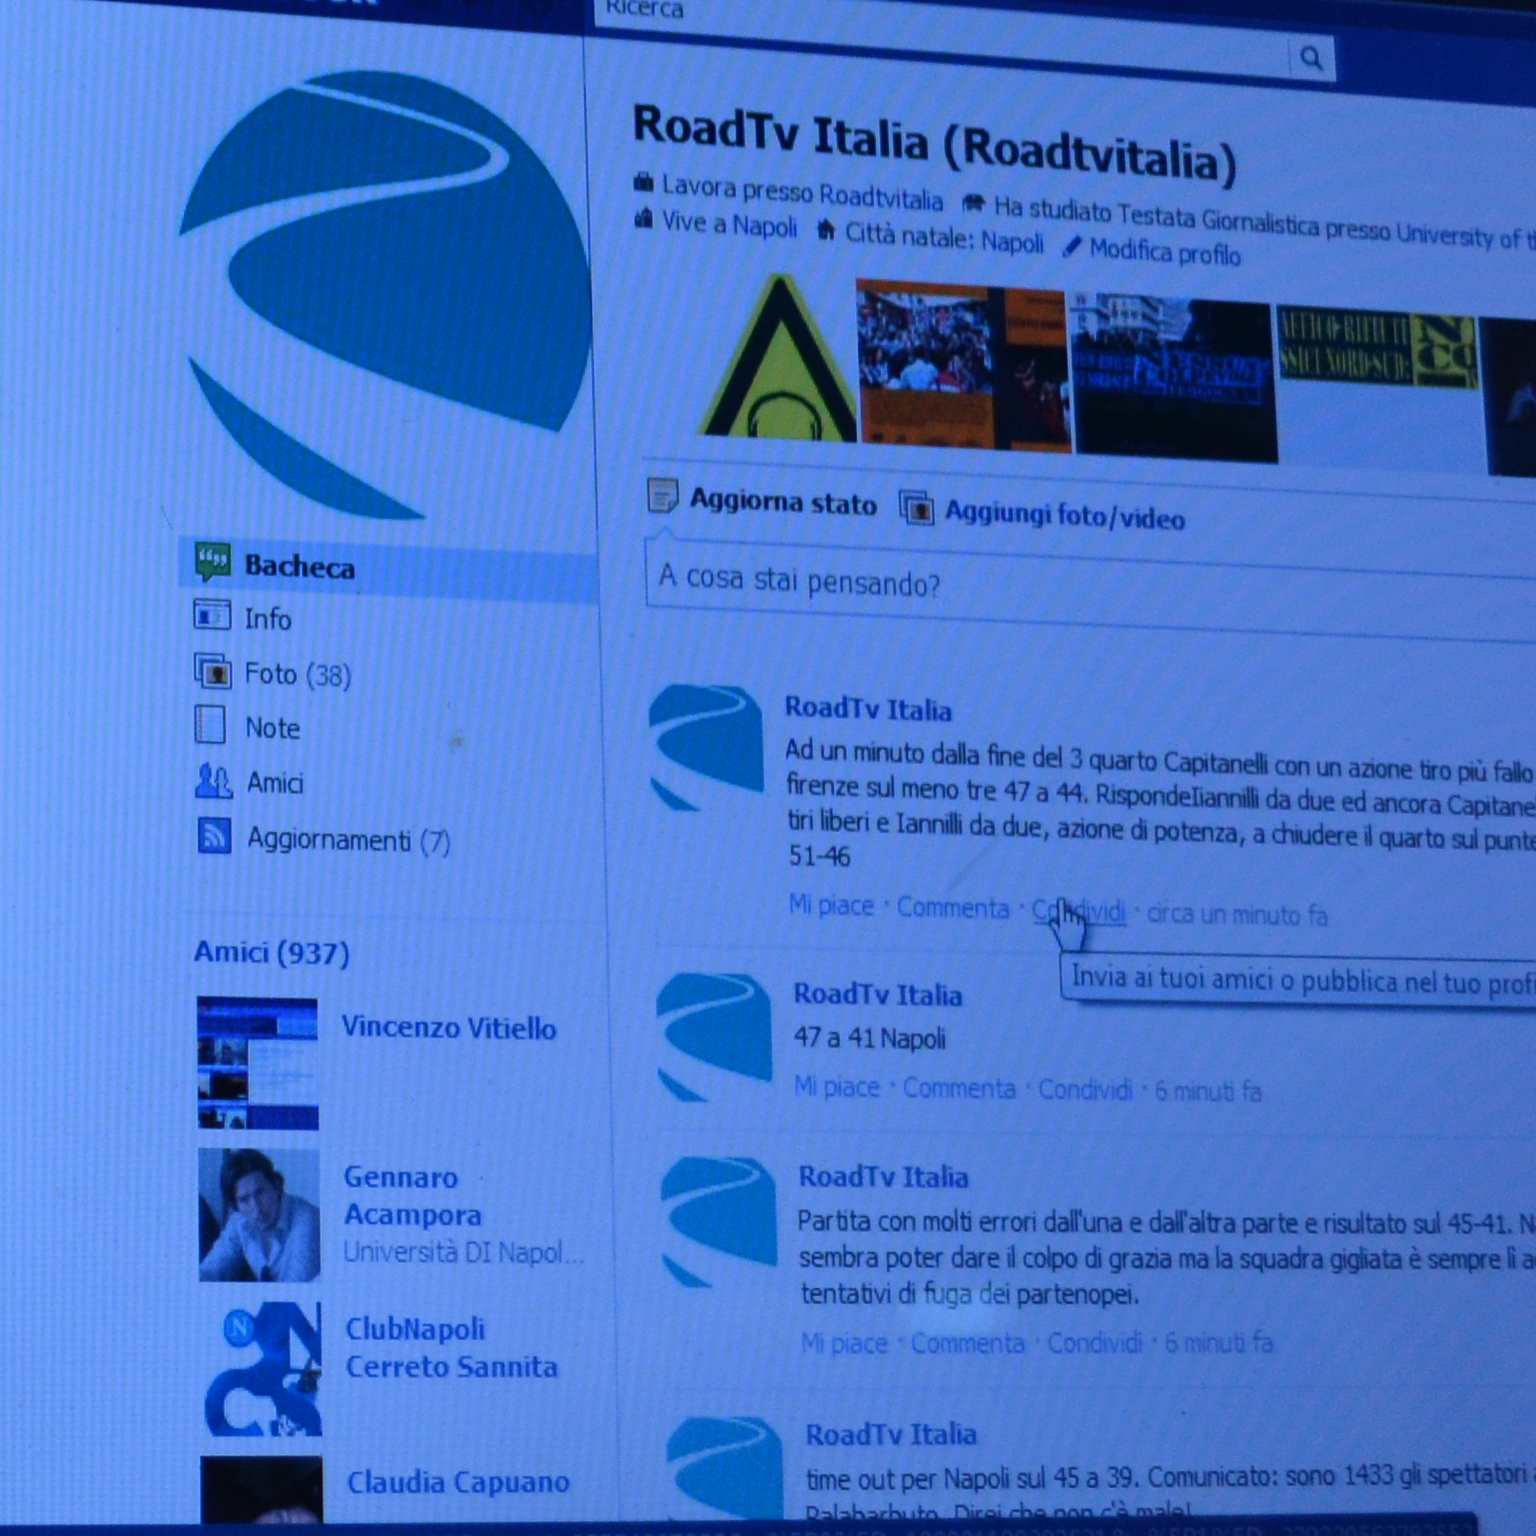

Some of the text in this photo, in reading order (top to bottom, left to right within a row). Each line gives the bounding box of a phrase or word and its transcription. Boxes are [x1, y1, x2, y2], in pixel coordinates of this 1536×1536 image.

[633, 103, 1237, 191] RoadTv Italia (Roadtvitalia)
[662, 173, 945, 213] Lavora presso Roadtvitalia
[662, 209, 798, 240] Vive a Napoli
[844, 220, 1045, 257] Città natale: Napoli
[994, 195, 1522, 252] Ha studiato Testata Giornalistica presso University of
[1089, 236, 1243, 268] Modifica profilo
[690, 486, 878, 517] Aggiorna stato
[944, 498, 1187, 532] Aggiungi foto/video
[245, 552, 356, 581] Bacheca
[658, 561, 941, 599] A cosa stai pensando?
[245, 606, 293, 631] Info
[245, 660, 352, 693] Foto (38)
[785, 694, 953, 723] RoadTv Italia
[246, 715, 301, 741] Note
[785, 736, 1535, 785] Ad un minuto dalla fine del 3 quarto Capitanelli con un azione tiro più fallo
[247, 770, 304, 795] Amici
[786, 770, 860, 798] firenze
[865, 774, 896, 799] sul
[900, 780, 960, 801] meno
[966, 778, 997, 802] tre
[1003, 780, 1031, 802] 47
[1035, 786, 1050, 804] a
[1056, 781, 1089, 804] 44.
[1265, 787, 1292, 811] da
[1296, 788, 1336, 813] due
[1340, 790, 1368, 814] ed
[1372, 796, 1443, 816] ancora
[1446, 793, 1536, 820] Capitane
[247, 825, 451, 858] Aggiornamenti (7)
[789, 843, 852, 868] 51-46
[193, 938, 350, 971] Amici (937)
[794, 981, 963, 1008] RoadTv Italia
[1072, 962, 1536, 1002] Invia ai tuoi amici o pubblica nel tuo prof
[341, 1013, 558, 1041] Vincenzo Vitiello
[793, 1025, 947, 1054] 47 a 41 Napoli
[794, 1074, 1263, 1104] Mi piace Commenta Condividi 6 minuti fa
[343, 1164, 459, 1189] Gennaro
[799, 1163, 970, 1190] RoadTv Italia
[344, 1201, 482, 1231] Acampora
[797, 1208, 1514, 1238] Partita con molti errori dall'una e dall'altra parte e risultato sul 45-41.
[343, 1238, 459, 1264] Università
[465, 1239, 492, 1265] DI
[801, 1278, 1139, 1310] tentativi di fuga dei partenopei.
[345, 1314, 486, 1346] ClubNapoli
[345, 1354, 559, 1379] Cerreto Sannita
[806, 1420, 978, 1447] RoadTv Italia
[347, 1468, 571, 1499] Claudia Capuano
